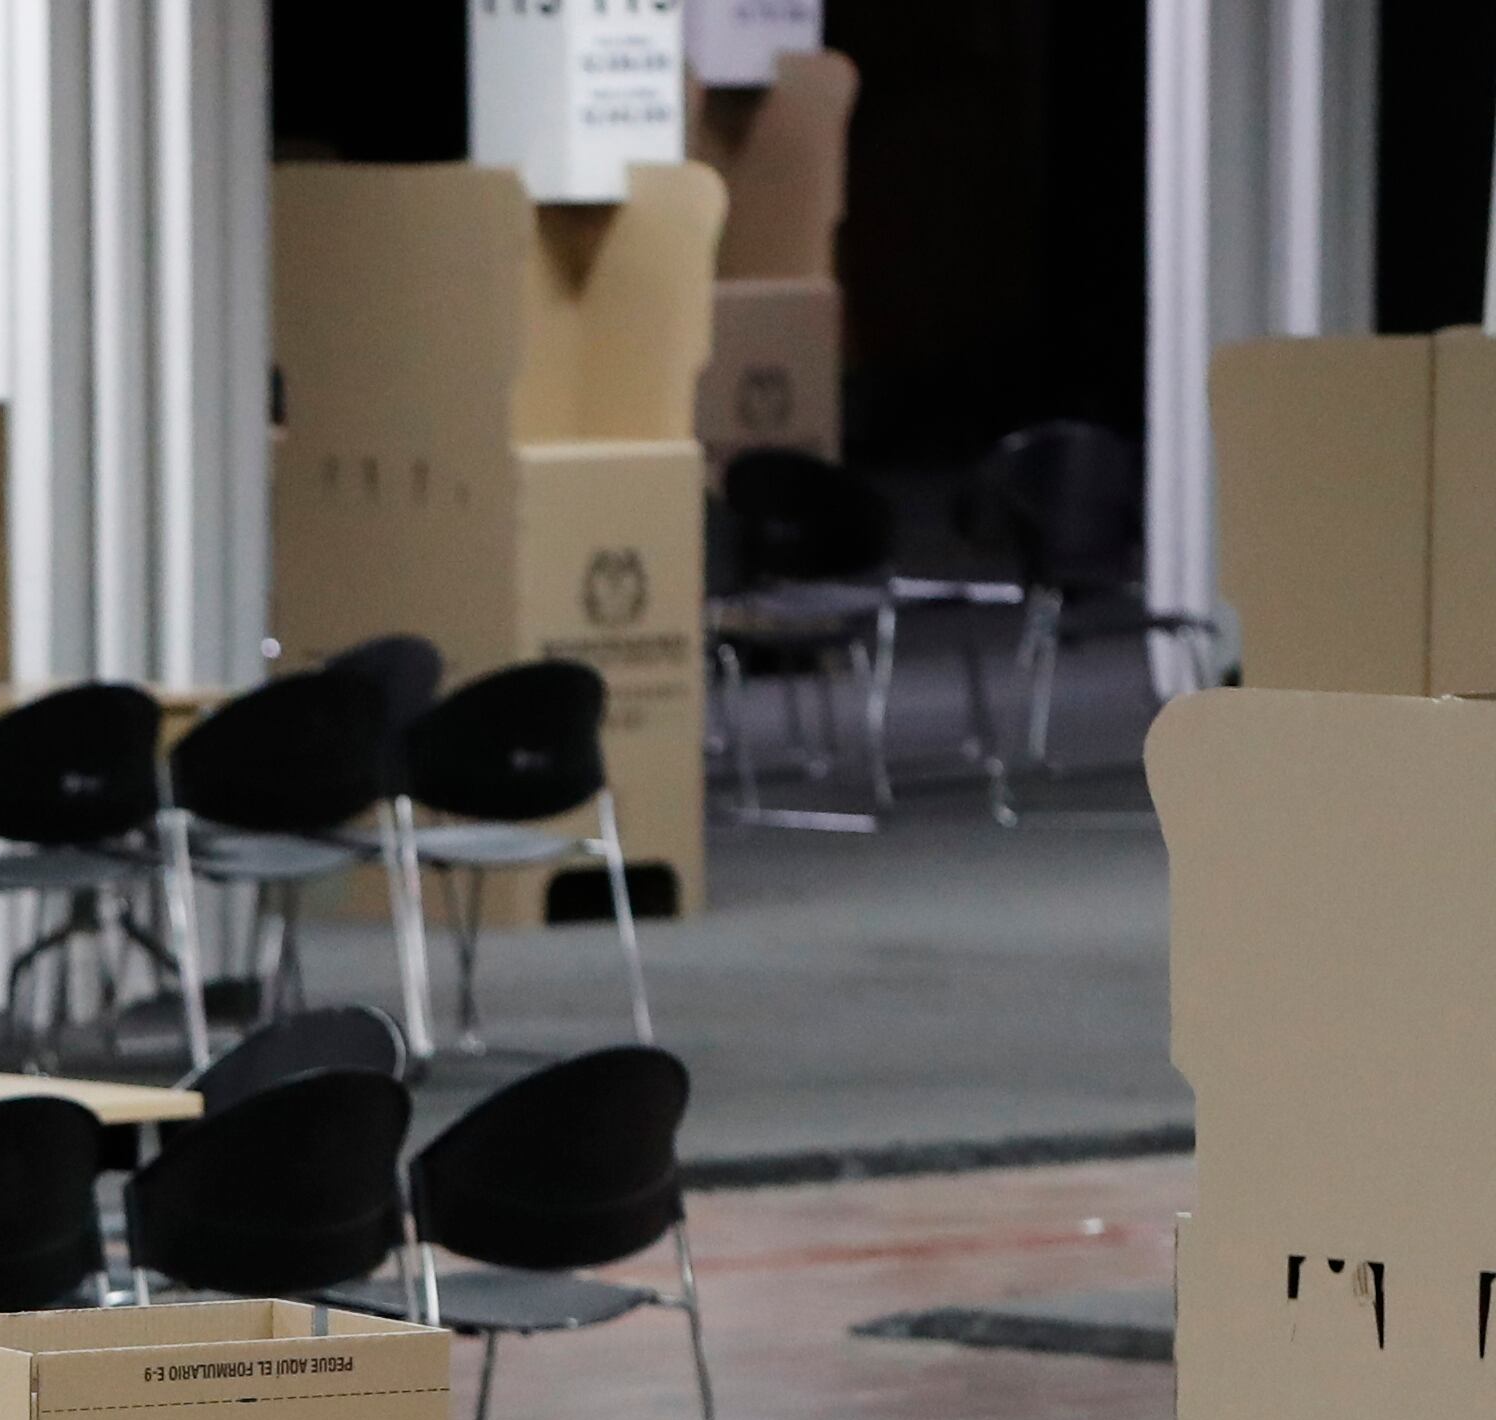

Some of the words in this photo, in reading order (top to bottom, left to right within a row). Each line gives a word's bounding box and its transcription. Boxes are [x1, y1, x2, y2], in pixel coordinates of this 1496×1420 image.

[169, 1362, 253, 1381] FORMULARIO
[258, 1360, 272, 1375] EL
[276, 1359, 307, 1378] AQUÍ
[311, 1356, 353, 1373] PEGUE
[144, 1367, 164, 1382] E-9
